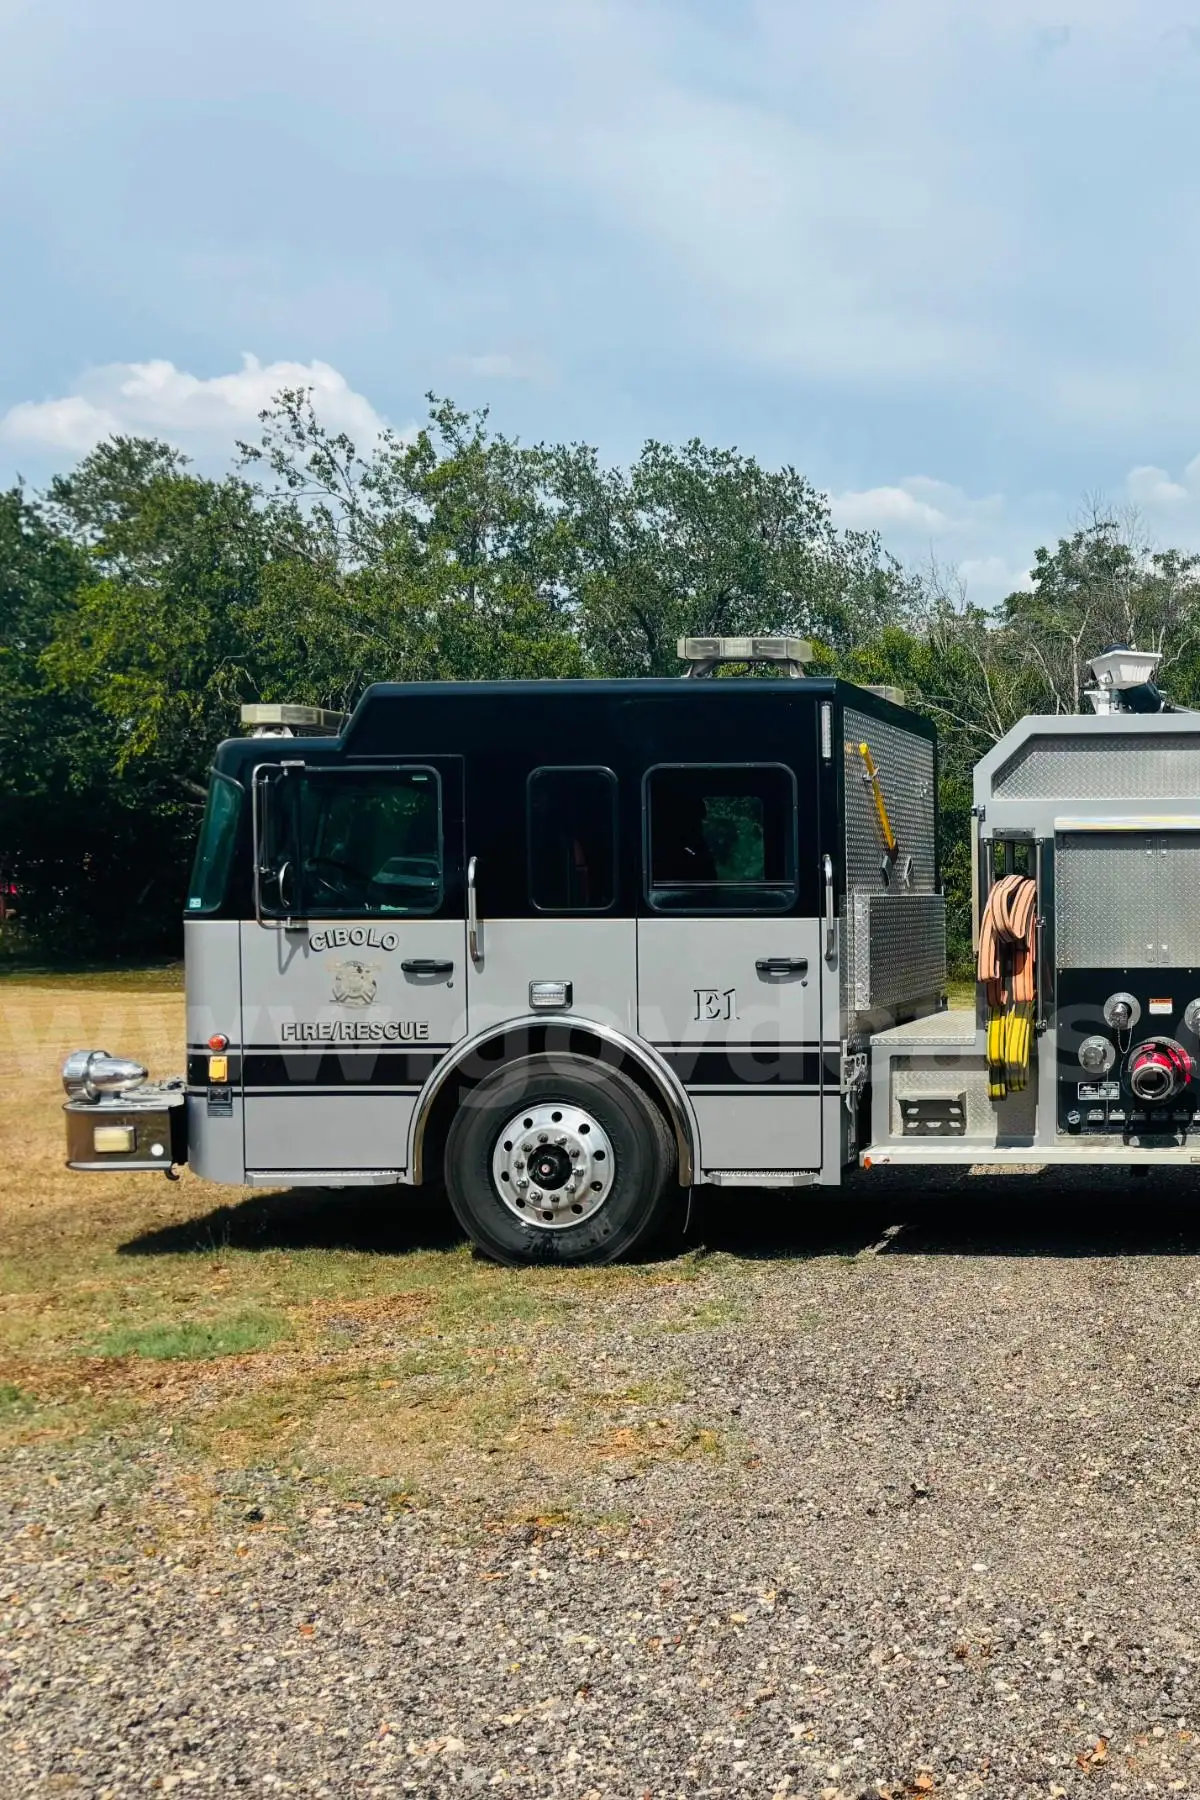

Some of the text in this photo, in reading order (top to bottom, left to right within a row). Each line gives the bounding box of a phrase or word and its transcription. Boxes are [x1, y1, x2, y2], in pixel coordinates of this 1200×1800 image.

[309, 927, 400, 952] CIBOLO
[693, 988, 740, 1020] E1
[281, 1020, 430, 1041] FIRE/RESCUE
